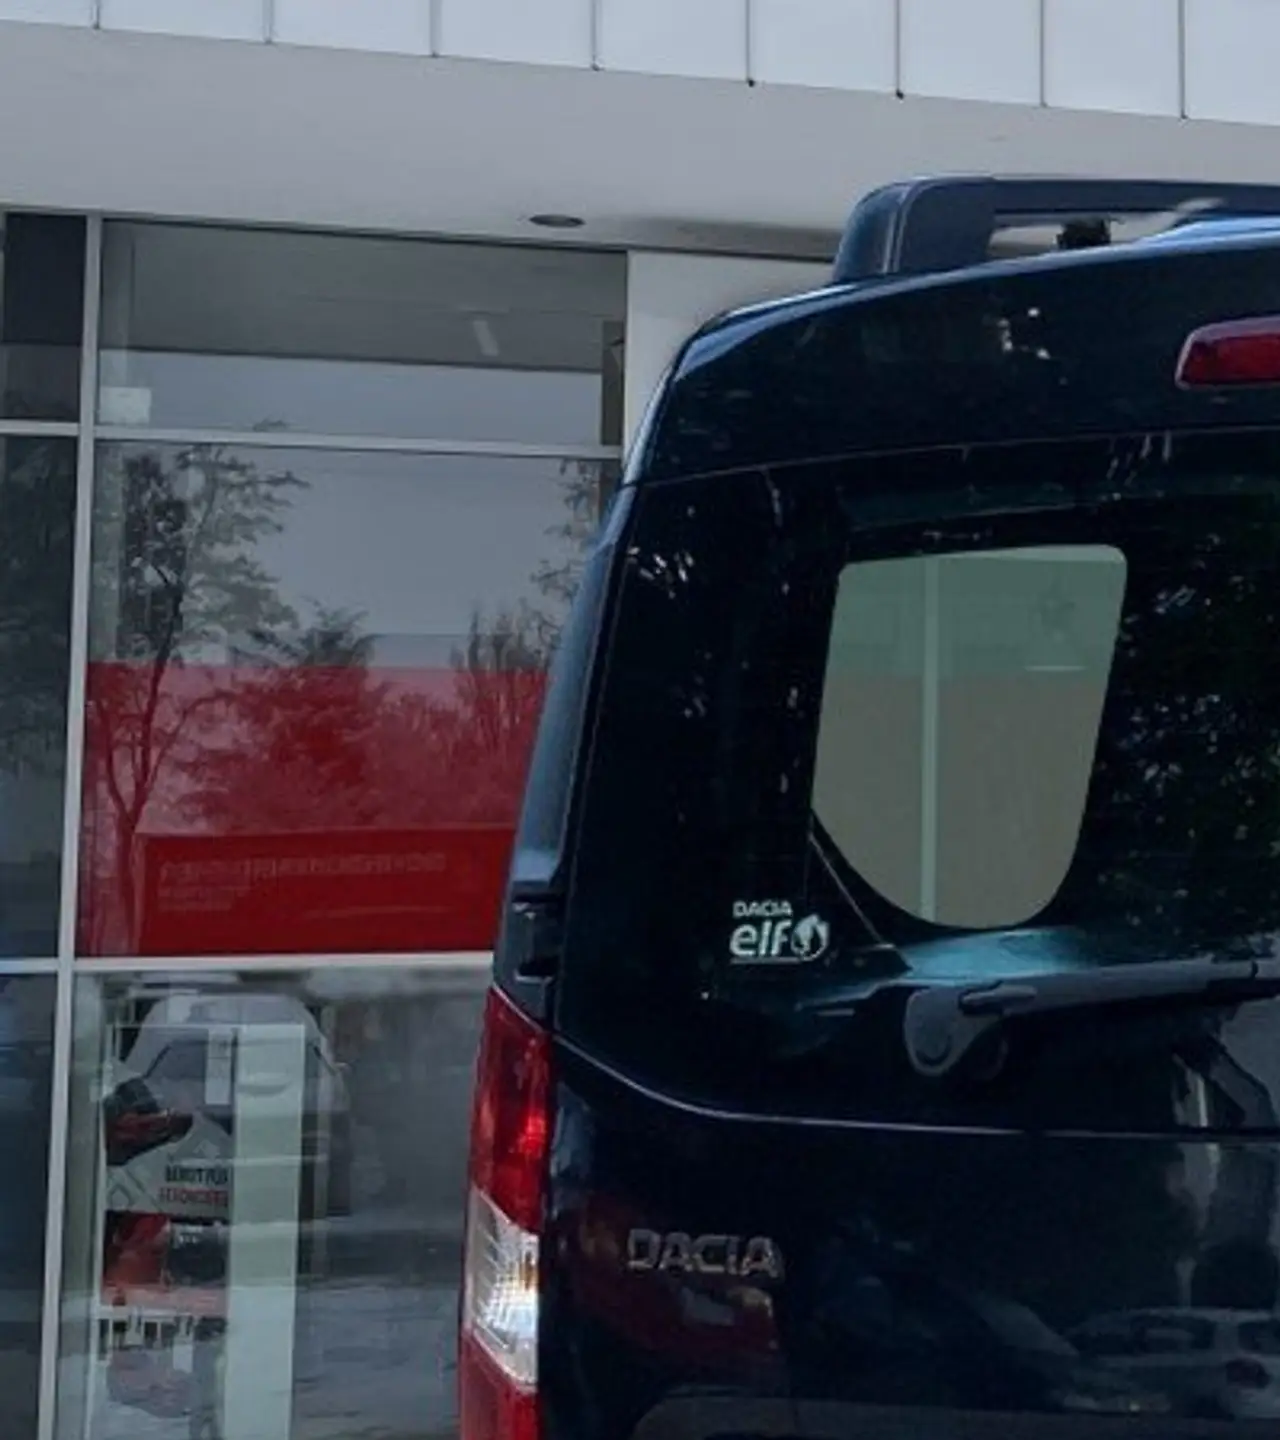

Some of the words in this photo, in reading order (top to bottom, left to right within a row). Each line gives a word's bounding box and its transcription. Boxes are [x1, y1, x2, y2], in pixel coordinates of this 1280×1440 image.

[732, 900, 793, 918] DACIA
[729, 920, 792, 956] elf
[627, 1228, 781, 1279] DACIA
